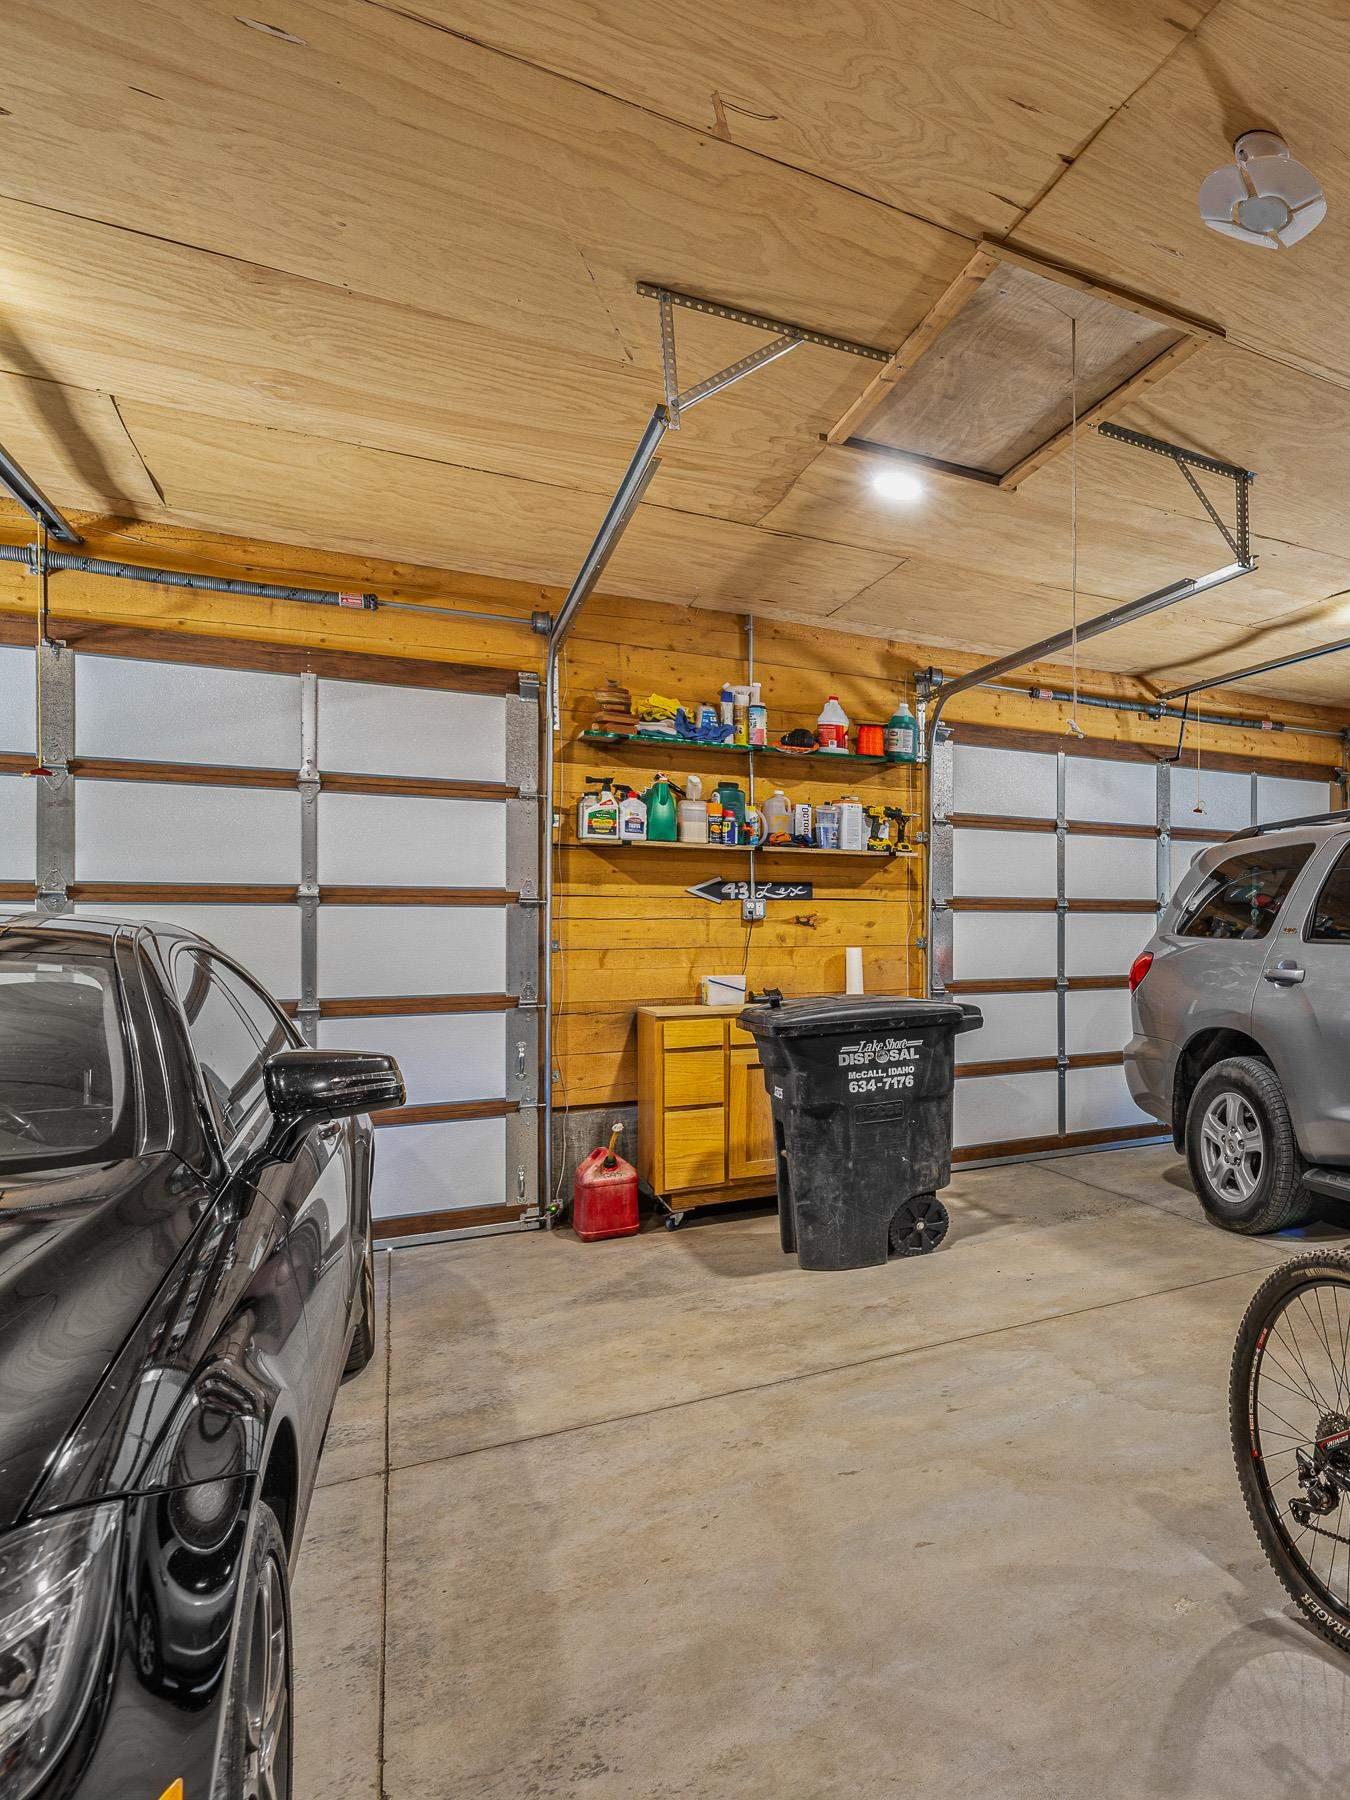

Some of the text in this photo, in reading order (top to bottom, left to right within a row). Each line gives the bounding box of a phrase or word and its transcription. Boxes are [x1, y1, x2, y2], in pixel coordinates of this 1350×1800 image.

[858, 1038, 908, 1052] Lake Shore
[848, 1065, 915, 1080] McCALL, IDAHO
[848, 1075, 914, 1093] 634-7176
